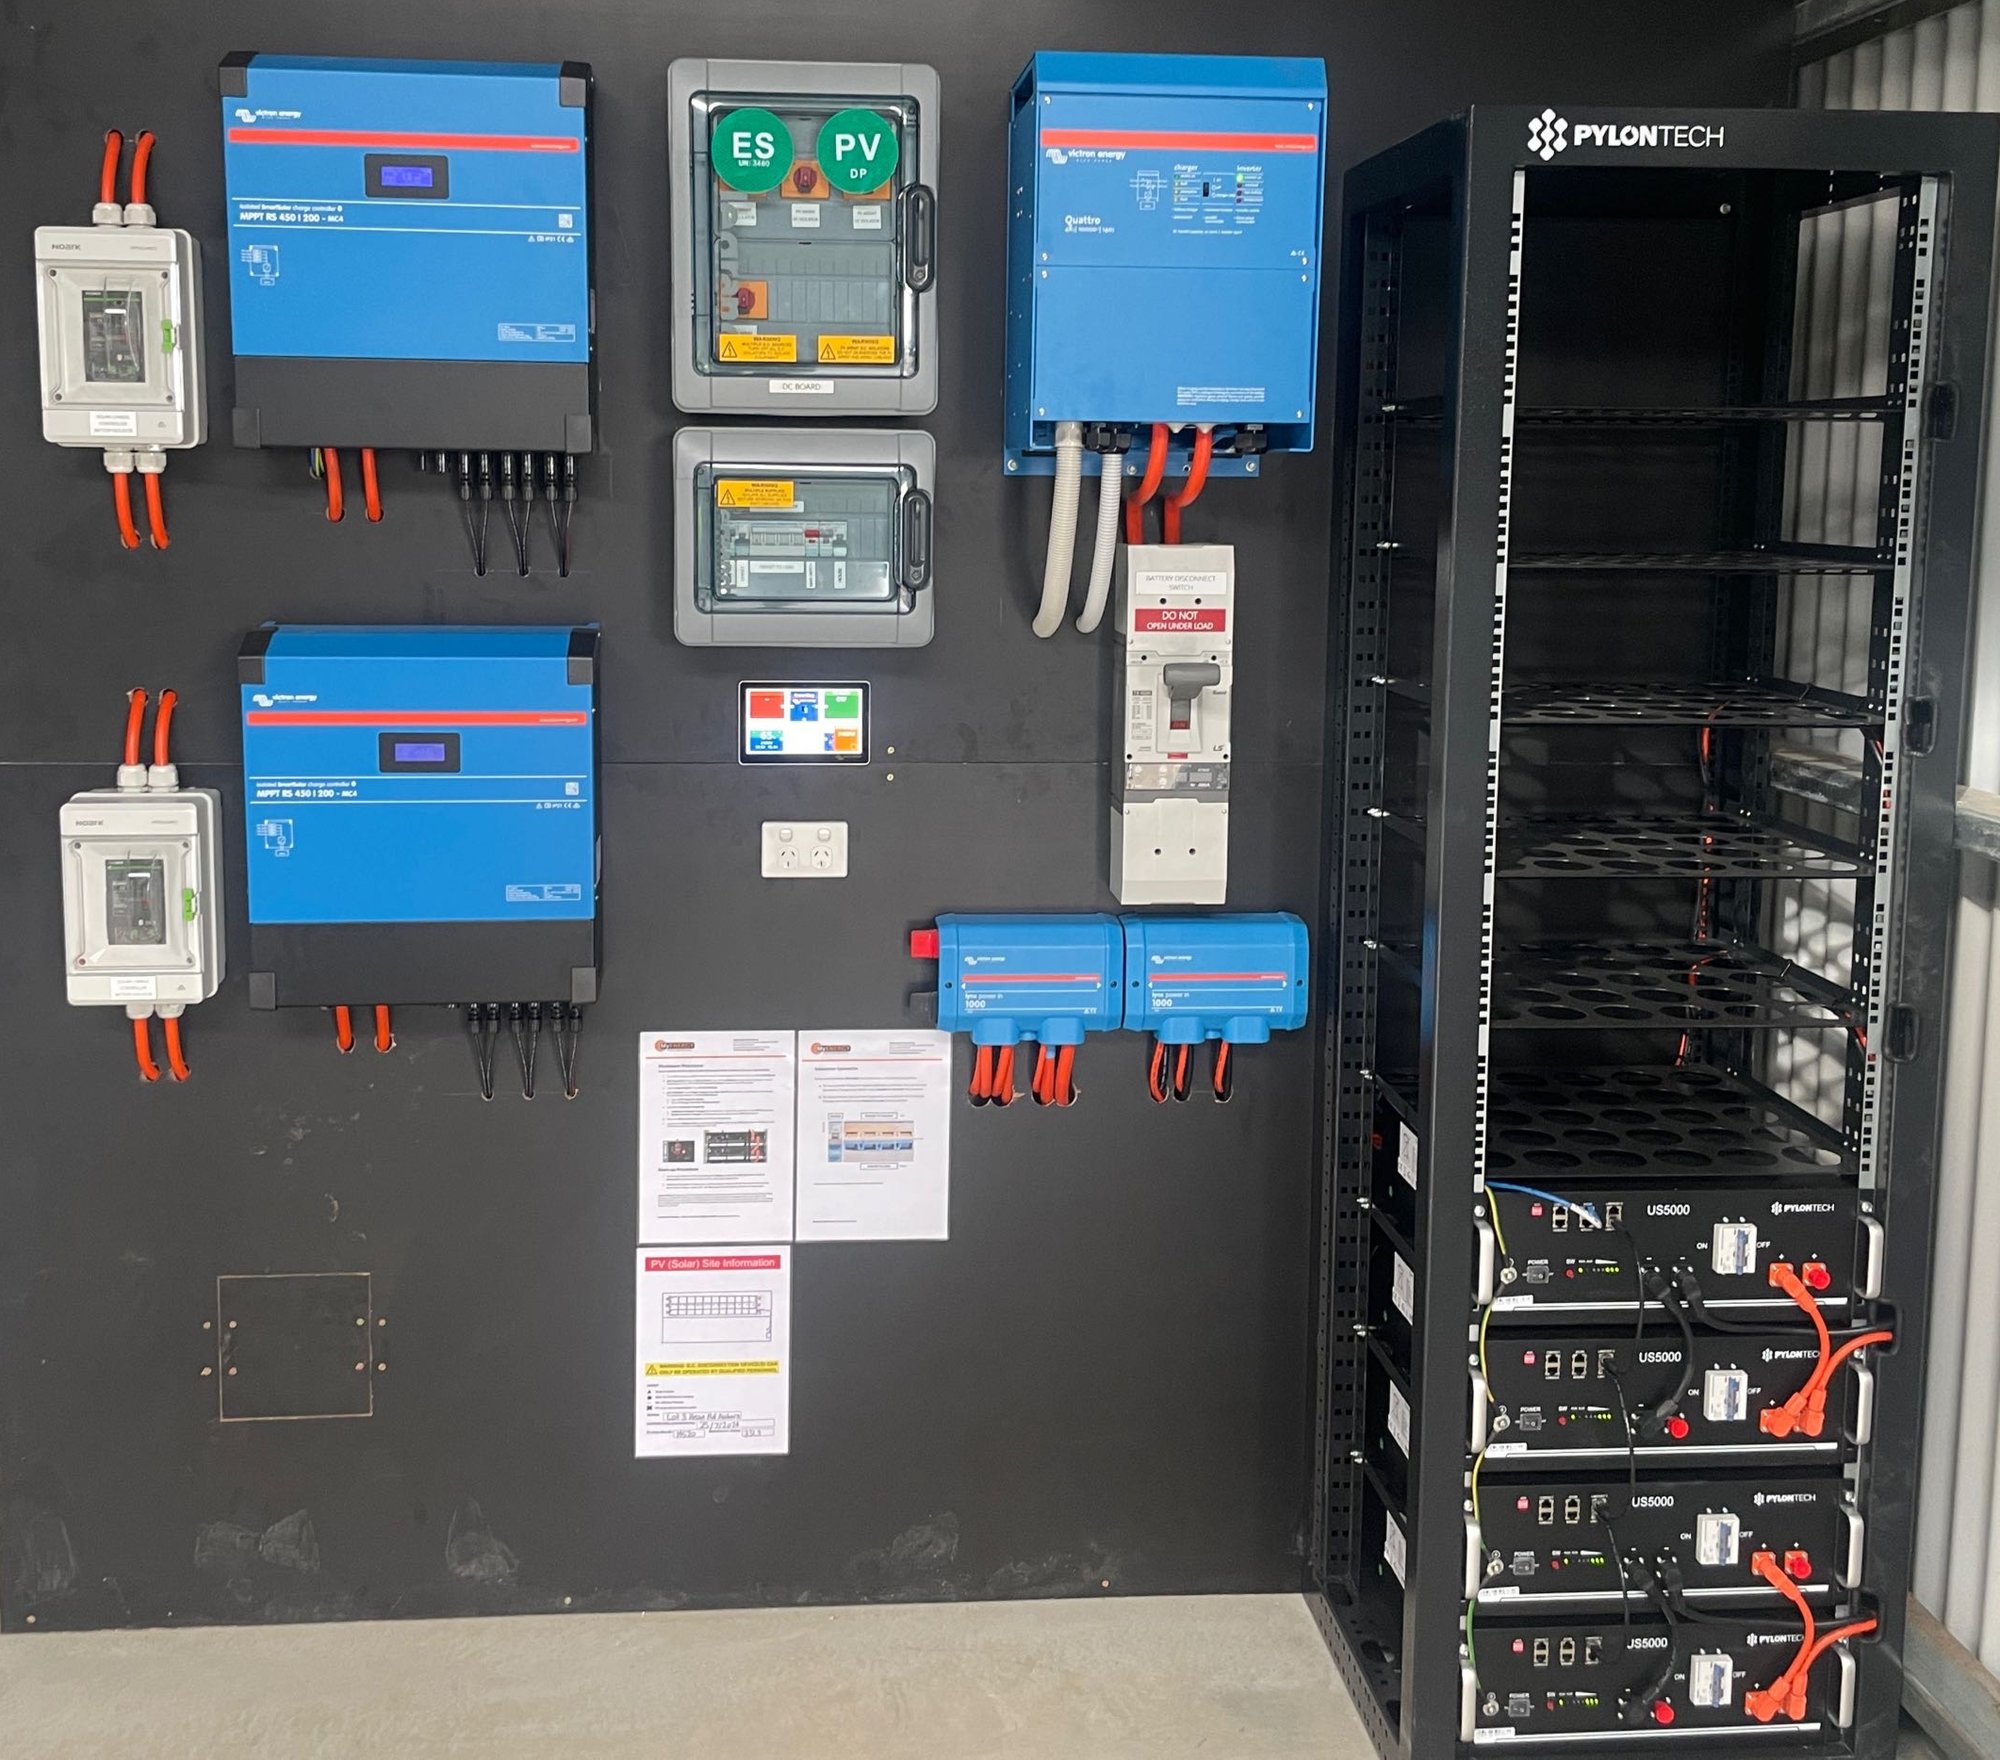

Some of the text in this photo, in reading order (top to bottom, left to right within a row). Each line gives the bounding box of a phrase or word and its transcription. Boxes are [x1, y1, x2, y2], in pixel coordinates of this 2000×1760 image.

[1574, 124, 1724, 148] PYLONTECH
[732, 131, 775, 159] ES
[835, 133, 882, 161] PV
[1068, 149, 1096, 159] victron
[1097, 150, 1127, 161] energy
[1174, 164, 1198, 172] charger
[1237, 165, 1262, 173] inverter
[850, 168, 867, 179] DP
[240, 212, 265, 221] MPPT
[266, 213, 277, 221] RS
[279, 213, 296, 222] 450
[303, 213, 320, 222] 200
[328, 215, 344, 223] MC4
[1065, 215, 1101, 228] Quattro
[795, 383, 821, 391] BOARD
[1162, 611, 1198, 620] DO NOT
[1194, 622, 1214, 630] LOAD
[256, 790, 280, 798] MPPT
[281, 790, 293, 798] RS
[295, 789, 311, 798] 450
[318, 789, 335, 798] 200
[341, 790, 357, 798] MC4
[965, 1000, 986, 1008] 1000
[1152, 999, 1172, 1007] 1000
[1647, 1204, 1690, 1217] US5000
[1783, 1203, 1835, 1213] PYLONTECH
[1696, 1242, 1708, 1250] ON
[1757, 1241, 1771, 1249] OFF
[651, 1257, 775, 1270] PV (Solar) Site Information
[1639, 1351, 1682, 1363] US5000
[1774, 1350, 1820, 1359] PYLONTEC
[1688, 1388, 1699, 1396] ON
[1747, 1387, 1761, 1395] OFF
[1632, 1495, 1674, 1508] US5000
[1766, 1494, 1816, 1503] PYLONTECH
[1680, 1532, 1692, 1540] ON
[1739, 1531, 1753, 1539] OFF
[1759, 1634, 1804, 1644] PYLONTEC
[1674, 1673, 1685, 1681] ON
[1732, 1671, 1746, 1679] OFF
